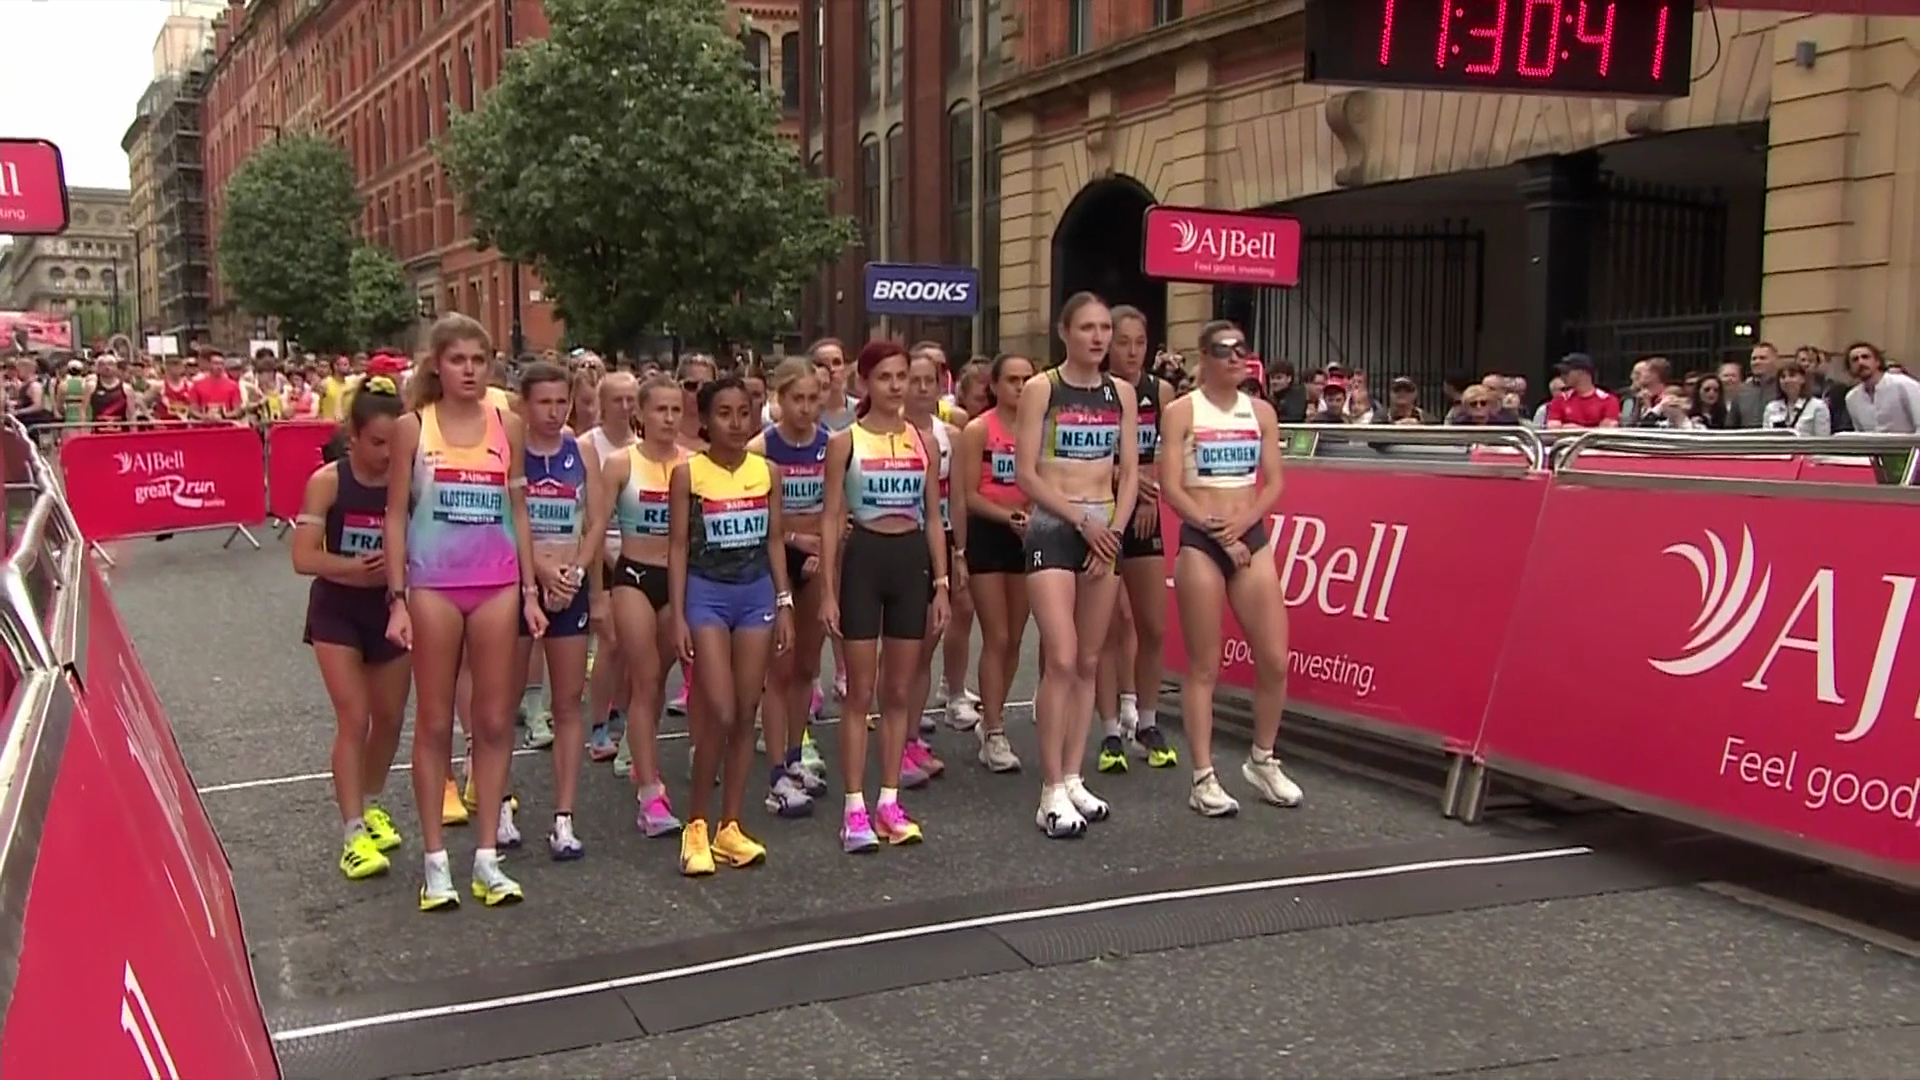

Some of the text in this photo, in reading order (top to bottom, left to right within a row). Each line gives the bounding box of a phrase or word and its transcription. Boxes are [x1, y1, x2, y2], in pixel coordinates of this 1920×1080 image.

[1196, 228, 1275, 261] AJBell
[873, 280, 970, 301] BROOKS
[1062, 430, 1114, 447] NEALE
[133, 450, 185, 475] AJBell
[1202, 446, 1256, 464] OCKENDEN
[135, 480, 215, 504] great run
[782, 481, 824, 498] HILLIPS
[868, 476, 922, 494] LUKAN
[711, 515, 764, 536] KELATI
[1741, 567, 1920, 742] AJ
[1288, 648, 1377, 697] nvesting.
[1719, 736, 1798, 791] Feel
